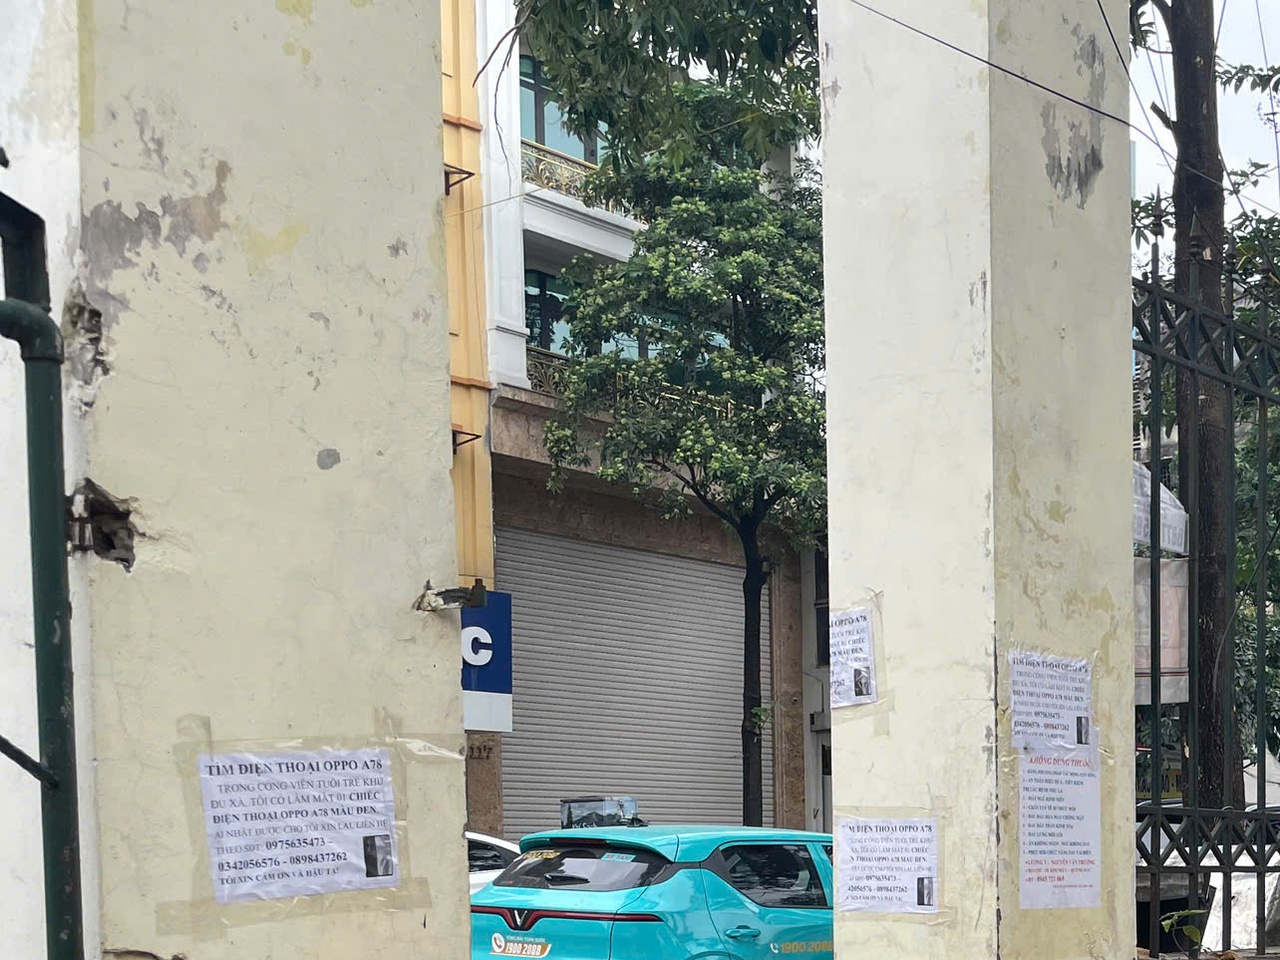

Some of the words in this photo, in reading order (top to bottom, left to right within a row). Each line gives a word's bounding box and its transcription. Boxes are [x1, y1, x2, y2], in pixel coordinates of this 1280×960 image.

[276, 761, 320, 775] THOẠI
[323, 760, 358, 772] OPPO
[361, 759, 383, 770] A78
[217, 782, 255, 794] TRONG
[242, 811, 278, 822] THOẠI
[280, 809, 309, 818] OPPO
[312, 808, 329, 817] A78
[289, 851, 347, 866] 0898437262
[505, 942, 522, 954] 1900
[522, 943, 542, 955] 2088
